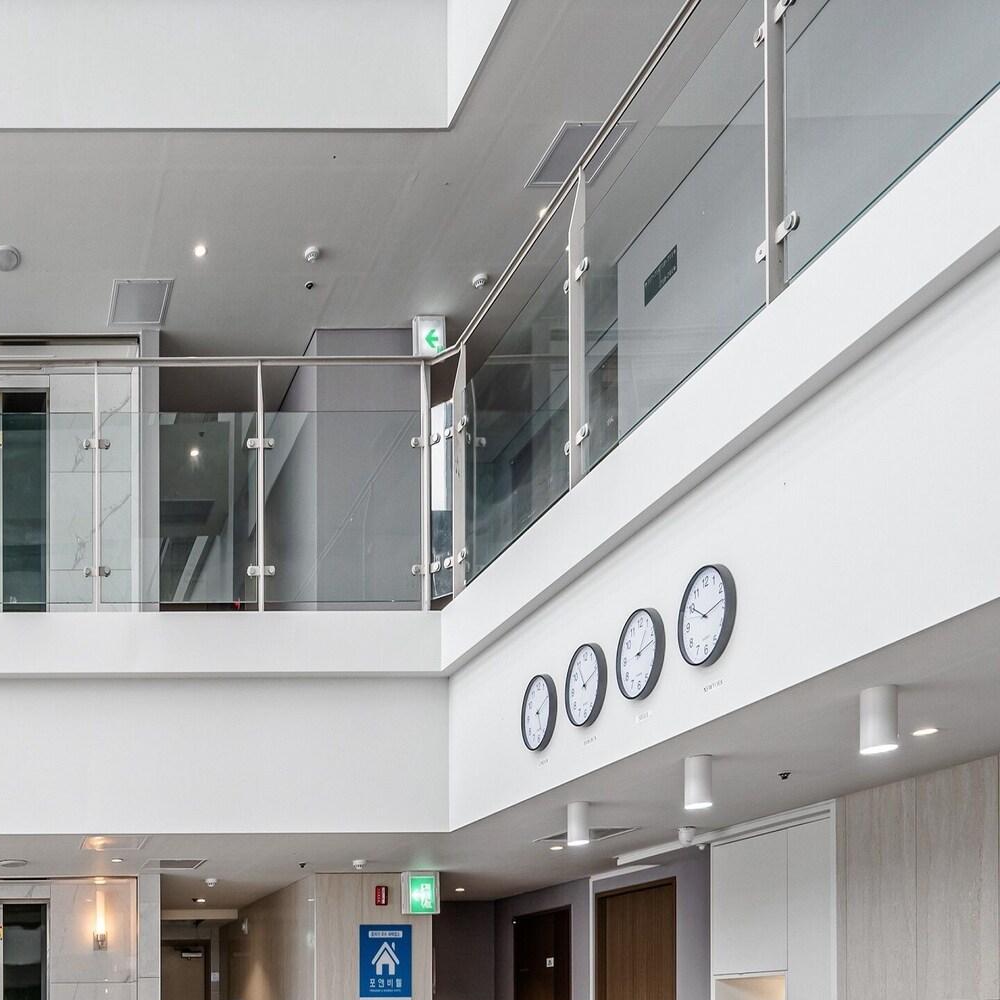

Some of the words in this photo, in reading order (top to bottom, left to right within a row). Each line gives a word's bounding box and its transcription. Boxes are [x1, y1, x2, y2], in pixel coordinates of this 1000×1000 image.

[702, 576, 709, 588] 12
[694, 588, 700, 599] 11
[637, 617, 644, 628] 12
[704, 645, 709, 655] 6
